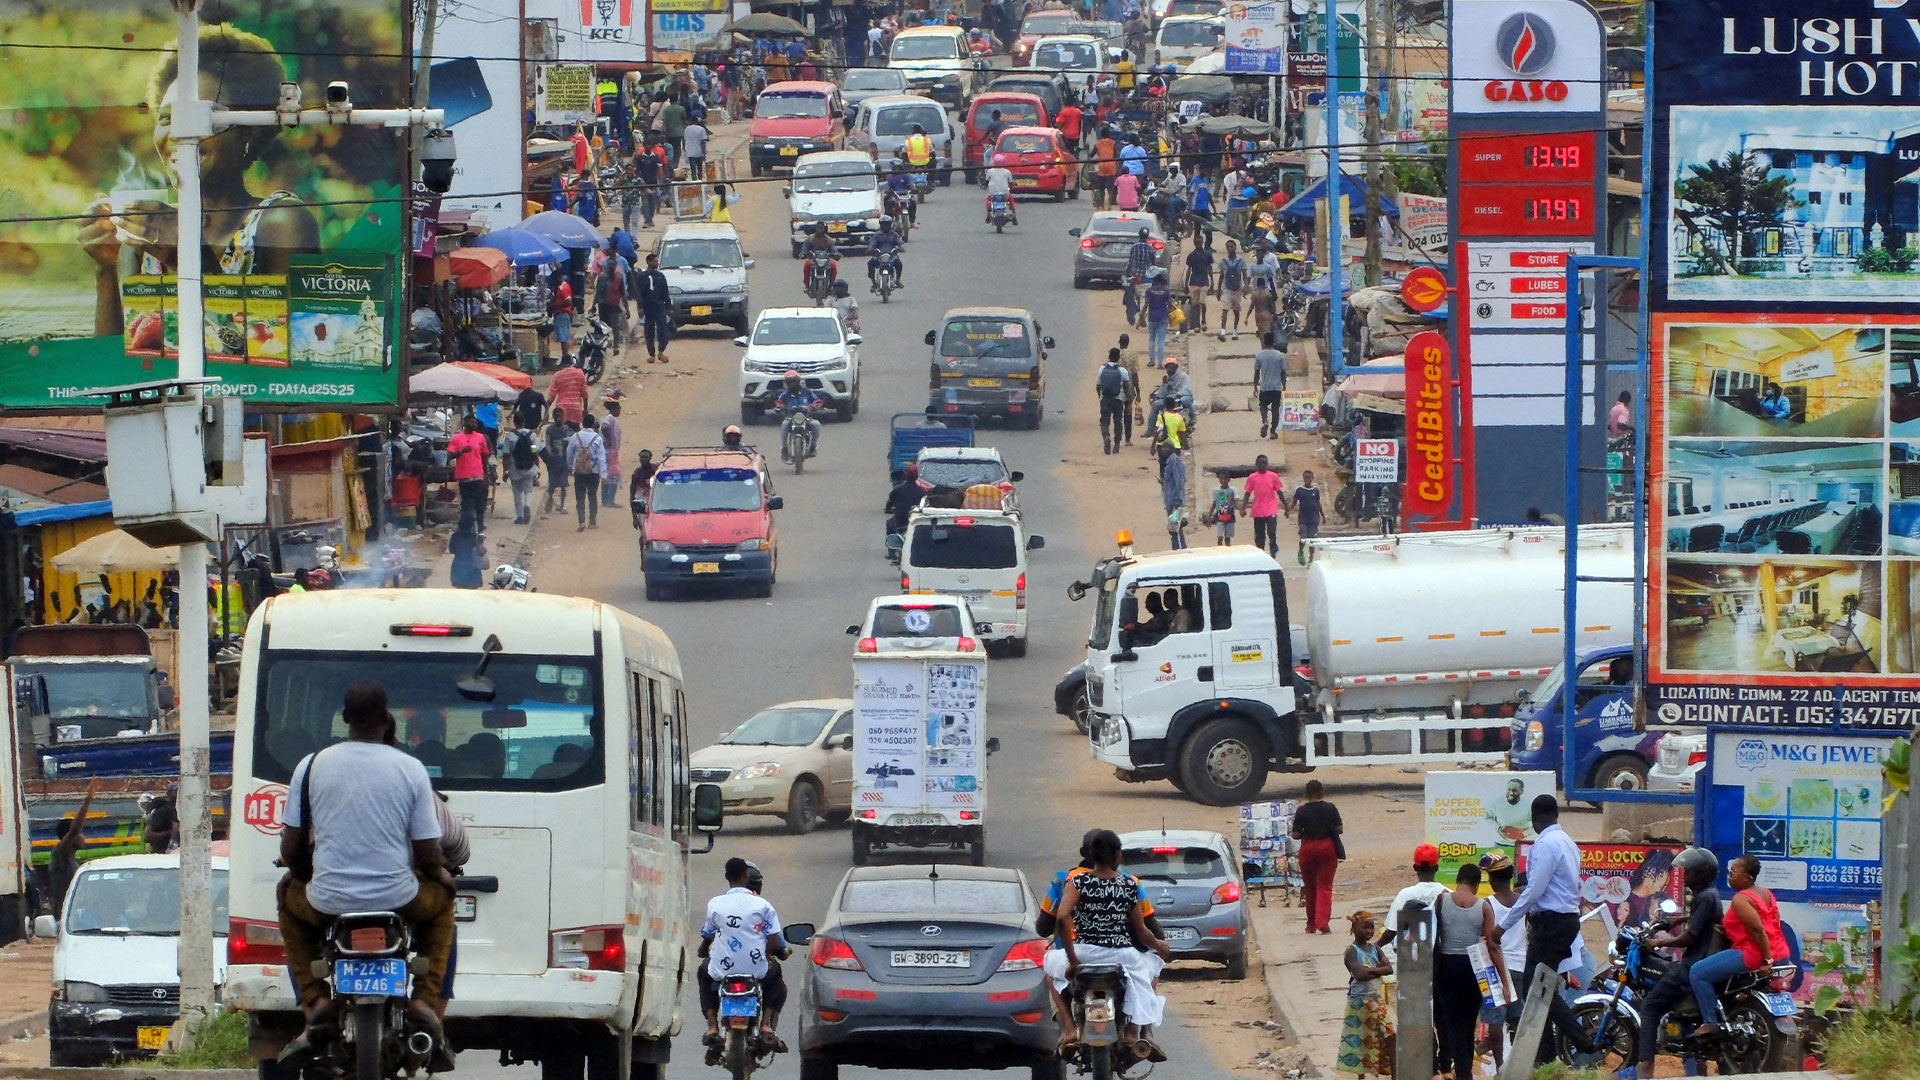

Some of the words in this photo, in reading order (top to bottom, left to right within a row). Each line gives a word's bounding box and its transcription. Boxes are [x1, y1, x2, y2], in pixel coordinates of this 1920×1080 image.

[659, 13, 706, 32] GAS
[590, 28, 624, 40] KFC
[1722, 17, 1884, 55] LUSH
[1799, 60, 1920, 97] HOT
[1484, 80, 1569, 102] GASO
[1474, 153, 1502, 161] SUPER
[1531, 145, 1580, 168] 13.49
[1474, 206, 1503, 215] DIESEL
[1531, 198, 1580, 220] 17.97
[1408, 235, 1428, 250] 024
[1527, 255, 1559, 265] STORE
[302, 276, 372, 292] VICTORIA
[1528, 281, 1560, 290] LUBES
[1531, 306, 1556, 315] FOOD
[47, 386, 78, 398] THIS
[268, 382, 355, 396] FDAfAd25S25
[1415, 346, 1444, 503] CediBites
[1365, 443, 1390, 455] NO
[1359, 465, 1394, 473] PARKING
[1154, 672, 1177, 683] Allied
[1659, 687, 1735, 700] LOCATION:
[1739, 689, 1786, 702] COMM.
[1790, 690, 1809, 702] 22
[1684, 704, 1789, 724] CONTACT:
[1739, 750, 1766, 761] M&G
[1770, 743, 1817, 762] M&G
[1434, 798, 1481, 807] SUFFER
[1429, 807, 1448, 817] NO
[1450, 807, 1486, 817] MORE
[1439, 842, 1477, 857] BIBINI
[1607, 850, 1645, 864] LOCKS
[1596, 869, 1635, 877] INSTITUTE
[1810, 864, 1838, 874] 0244
[1840, 865, 1861, 875] 283
[1810, 873, 1837, 883] 0200
[1840, 874, 1859, 884] 631
[894, 953, 907, 964] GW
[913, 952, 958, 965] 3890-22
[354, 977, 388, 992] 6746
